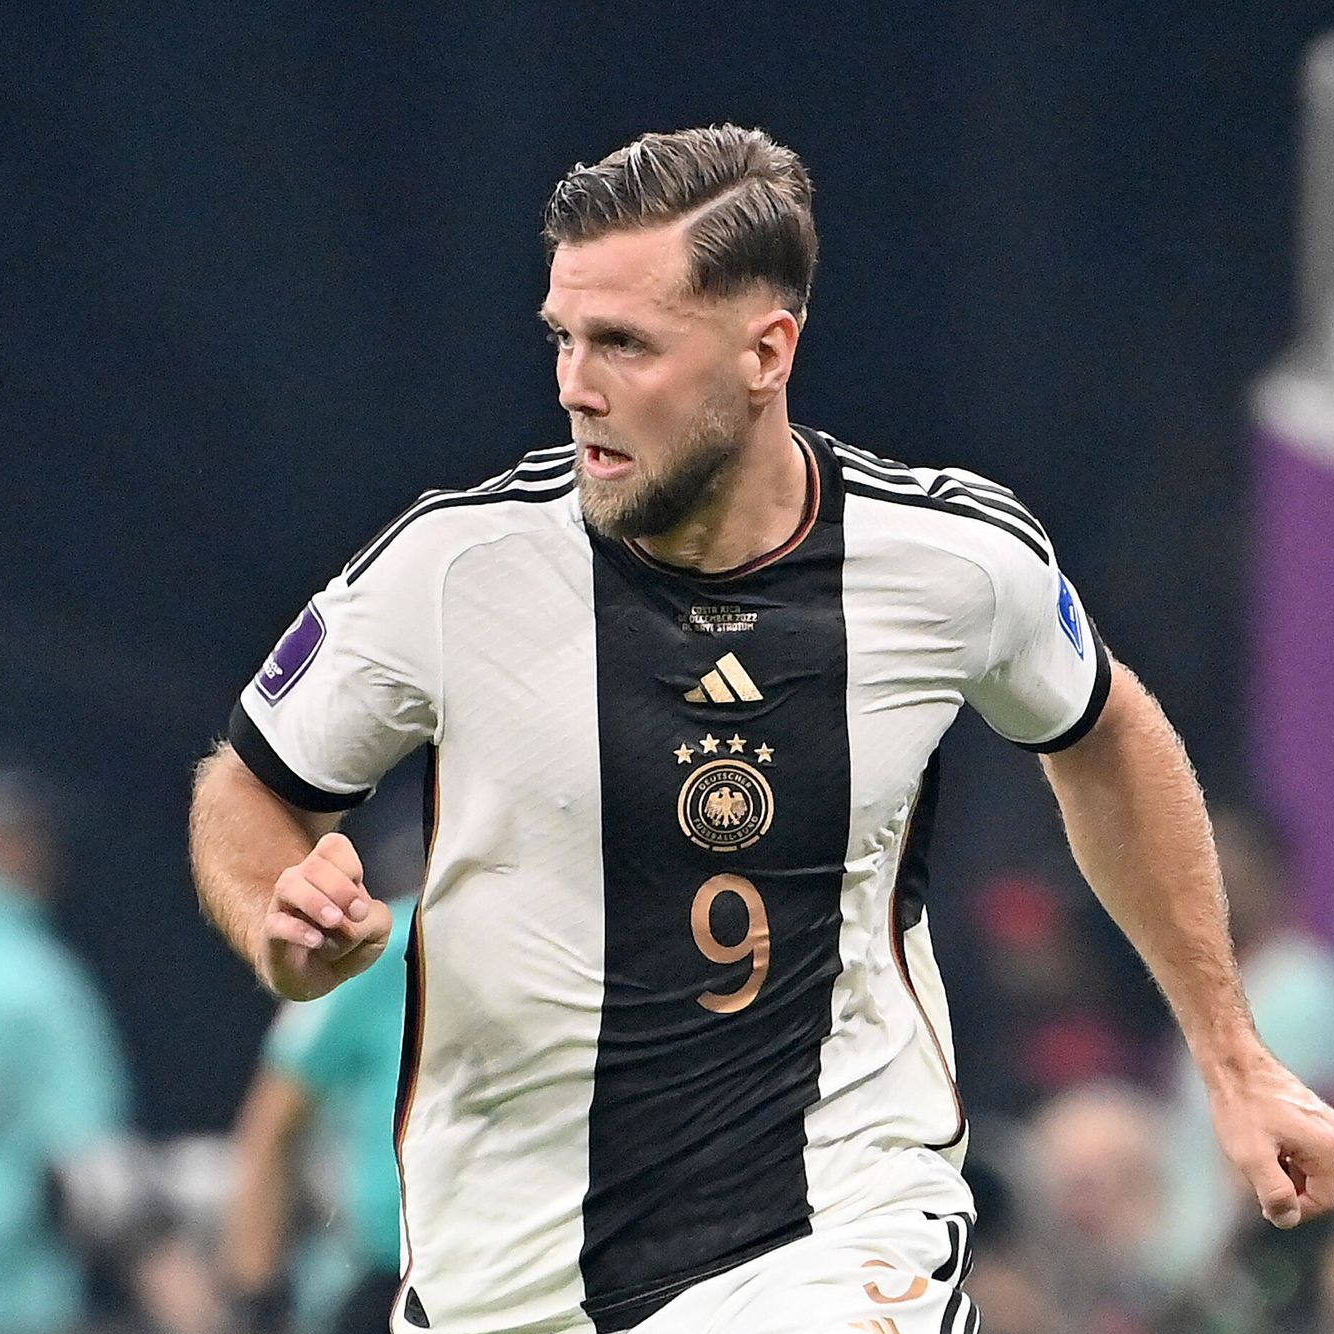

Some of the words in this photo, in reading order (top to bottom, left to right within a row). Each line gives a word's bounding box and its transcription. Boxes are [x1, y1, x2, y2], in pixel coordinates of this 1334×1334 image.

[735, 612, 758, 622] 2022
[698, 772, 753, 790] DEUTSCHER
[690, 872, 770, 1014] 9
